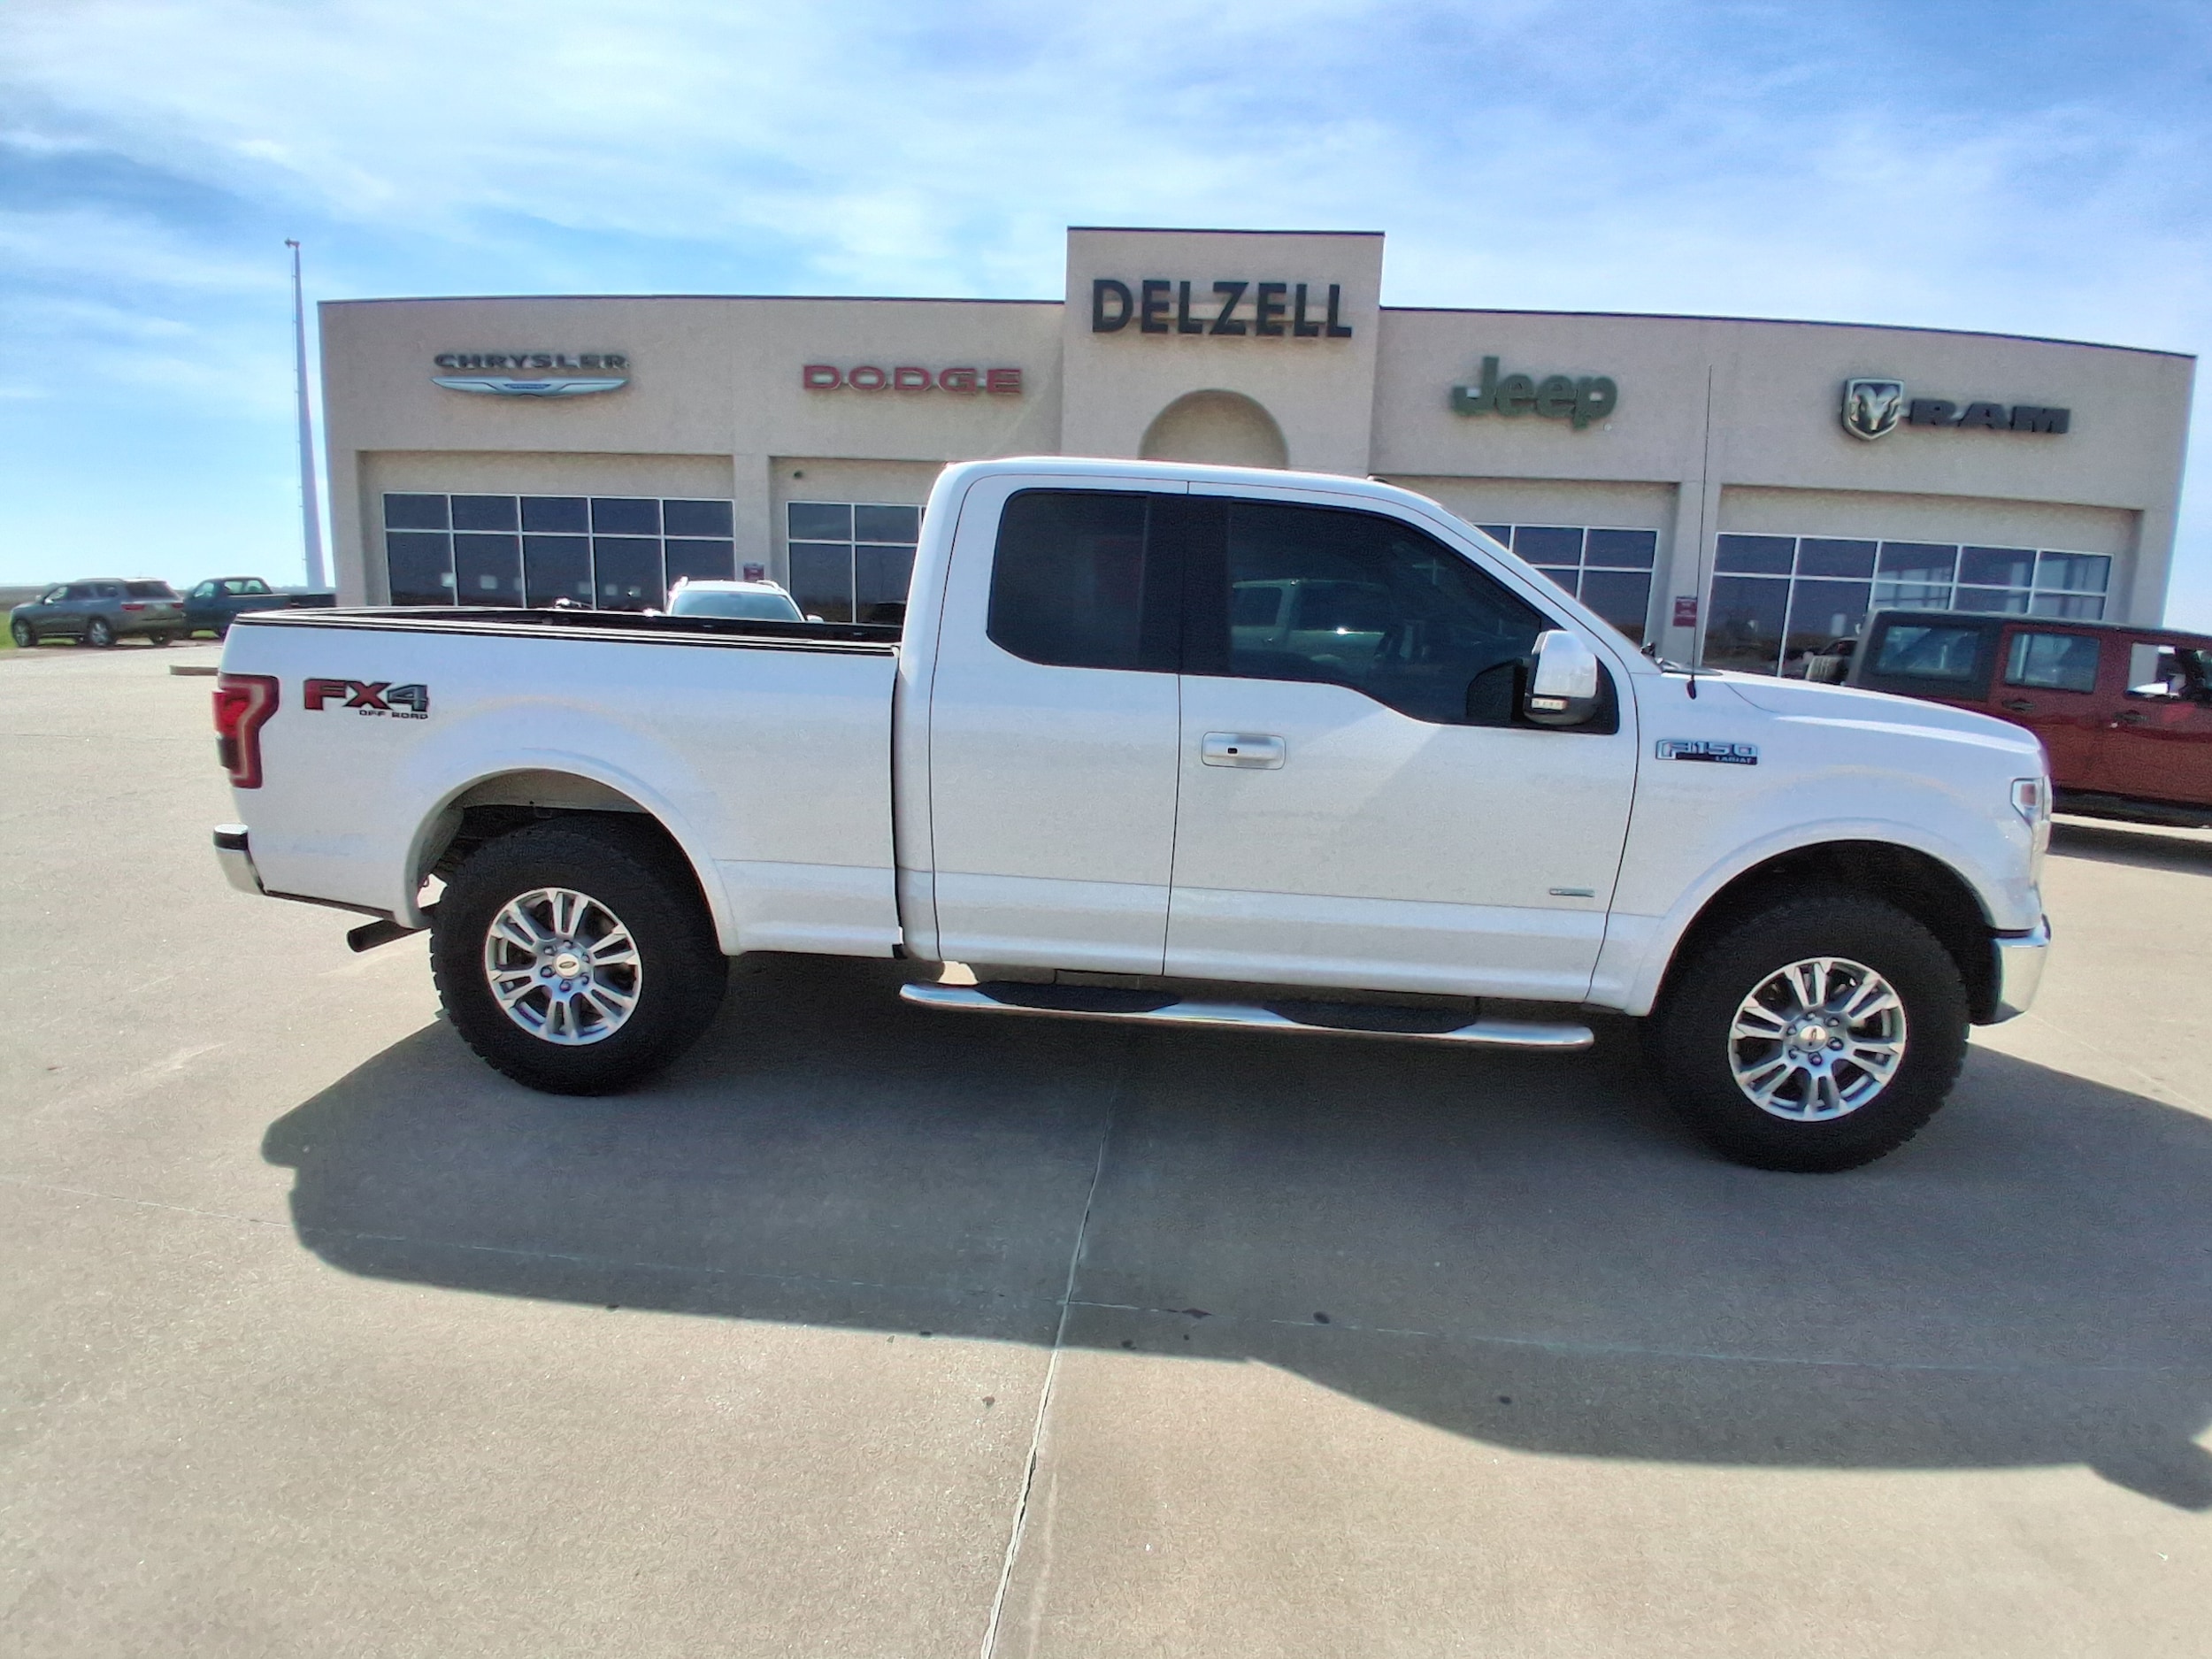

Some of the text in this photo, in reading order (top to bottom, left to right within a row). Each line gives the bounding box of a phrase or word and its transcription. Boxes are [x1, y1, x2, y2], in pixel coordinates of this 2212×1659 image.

[1093, 279, 1352, 338] DELZELL
[434, 353, 630, 370] CHRYSLER
[803, 365, 1022, 394] DODGE
[1451, 356, 1617, 430] Jeep
[1909, 398, 2071, 434] RAM
[303, 679, 428, 712] FX4
[392, 711, 428, 720] ROAD
